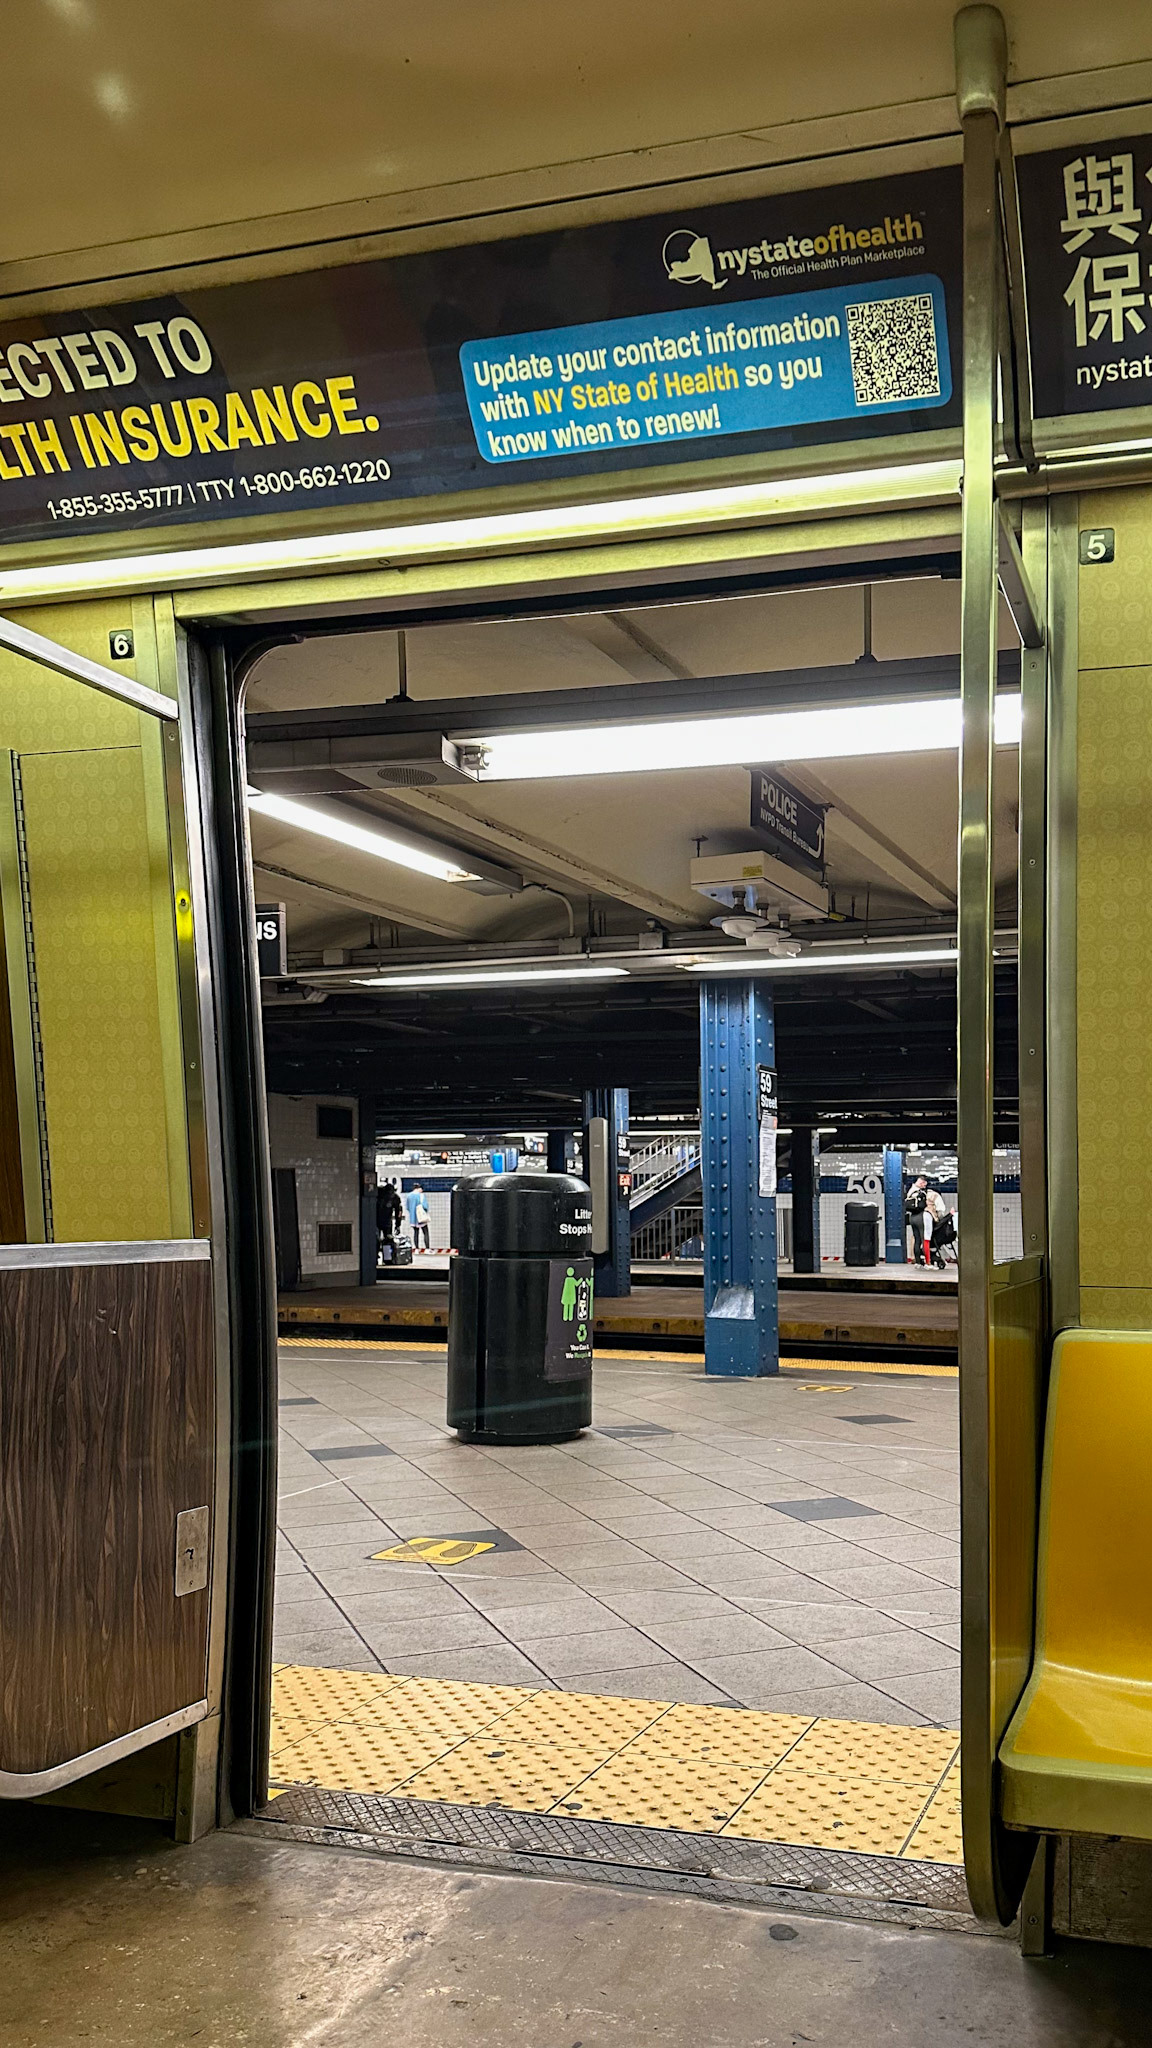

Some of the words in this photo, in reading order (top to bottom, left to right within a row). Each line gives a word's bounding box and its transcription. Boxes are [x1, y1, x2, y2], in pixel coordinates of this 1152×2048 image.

[1060, 153, 1152, 254] 與
[717, 213, 923, 275] nystateofhealth
[751, 269, 770, 281] The
[770, 262, 805, 278] Official
[806, 257, 839, 272] Health
[840, 254, 862, 267] Plan
[864, 244, 925, 263] Marketplace
[1063, 252, 1152, 347] 保
[134, 316, 213, 379] TO
[473, 353, 553, 392] Update
[557, 348, 607, 382] your
[613, 330, 702, 367] contact
[705, 312, 841, 355] information
[1077, 354, 1152, 389] nystat
[480, 390, 530, 422] with
[532, 387, 564, 416] NY
[571, 380, 631, 410] State
[636, 371, 658, 401] of
[664, 361, 740, 398] Health
[744, 364, 773, 388] so
[778, 356, 823, 390] you
[70, 375, 381, 469] INSURANCE.
[487, 430, 547, 457] know
[552, 420, 613, 449] when
[617, 415, 641, 441] to
[645, 403, 721, 437] renew!
[46, 484, 184, 520] 1-855-355-5777
[196, 477, 235, 502] TTY
[239, 458, 391, 497] 1-800-662-1220
[1087, 534, 1106, 560] 5
[114, 634, 129, 656] 6
[761, 778, 798, 826] POLICE
[761, 807, 776, 828] NYPD
[775, 817, 793, 841] Transit
[760, 1072, 772, 1094] 59
[760, 1093, 778, 1110] Street
[847, 1175, 883, 1195] 59
[559, 1223, 587, 1237] Stops
